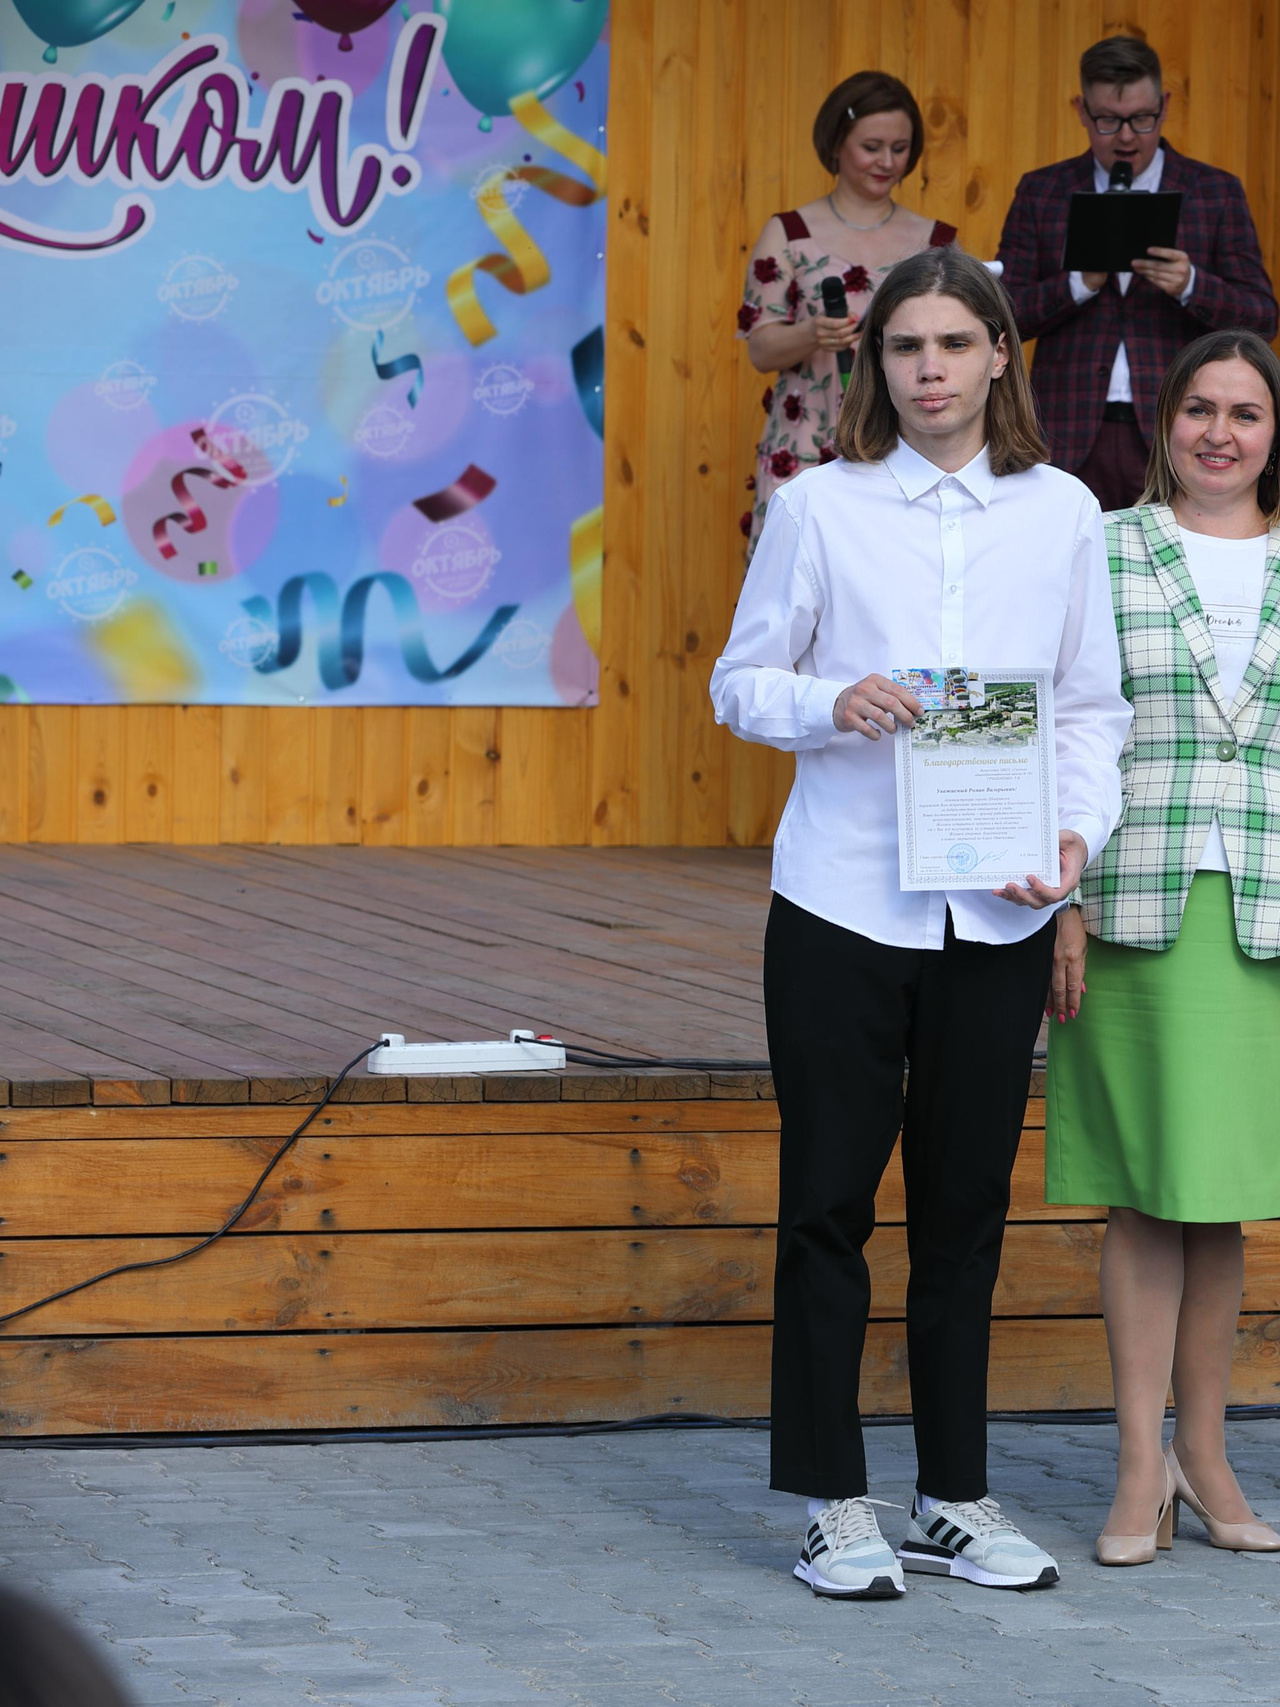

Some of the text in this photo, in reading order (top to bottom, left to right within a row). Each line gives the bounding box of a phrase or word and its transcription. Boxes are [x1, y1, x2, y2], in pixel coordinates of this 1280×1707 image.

[157, 272, 240, 303] ОКТЯБРЬ
[316, 264, 431, 305] ОКТЯБРЬ
[412, 545, 502, 578] ОКТЯБРЬ
[46, 567, 138, 600] ОКТЯБРЬ
[999, 757, 1029, 765] письмо
